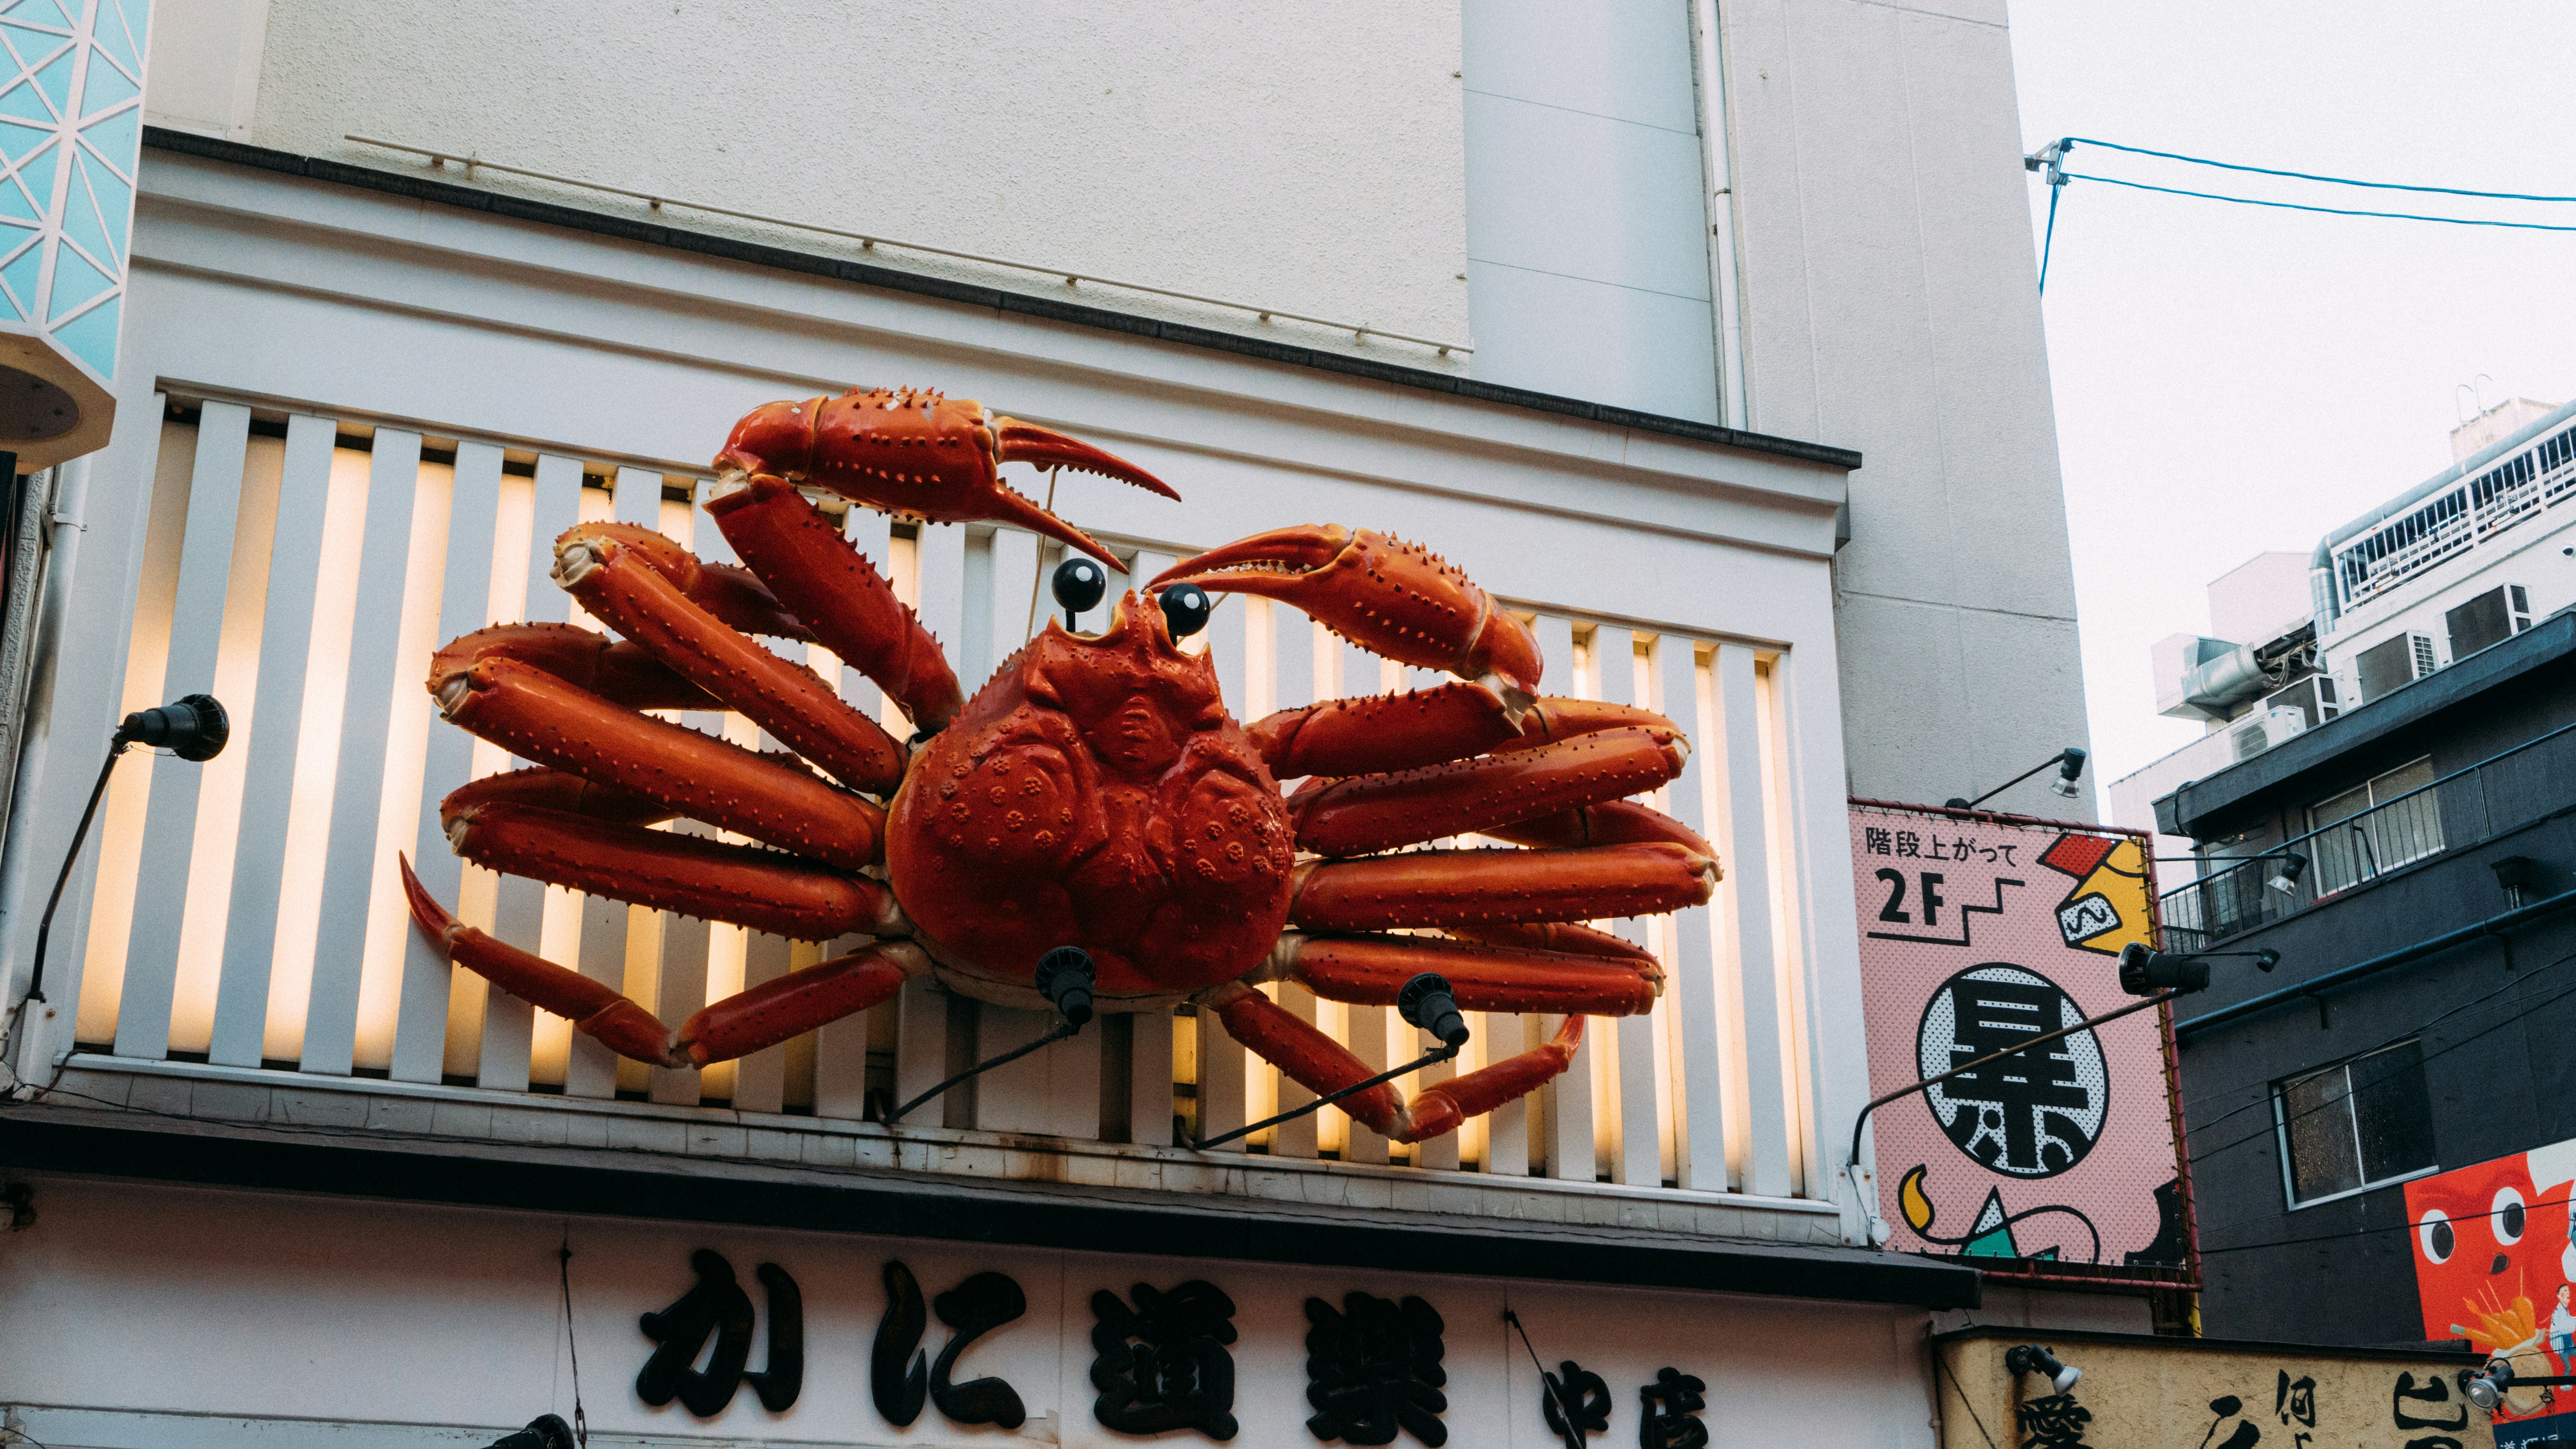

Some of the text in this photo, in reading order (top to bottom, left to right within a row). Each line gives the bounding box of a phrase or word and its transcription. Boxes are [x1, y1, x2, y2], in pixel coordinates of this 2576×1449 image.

[1865, 827, 2017, 867] 階段上がって
[1874, 867, 1944, 926] 2F
